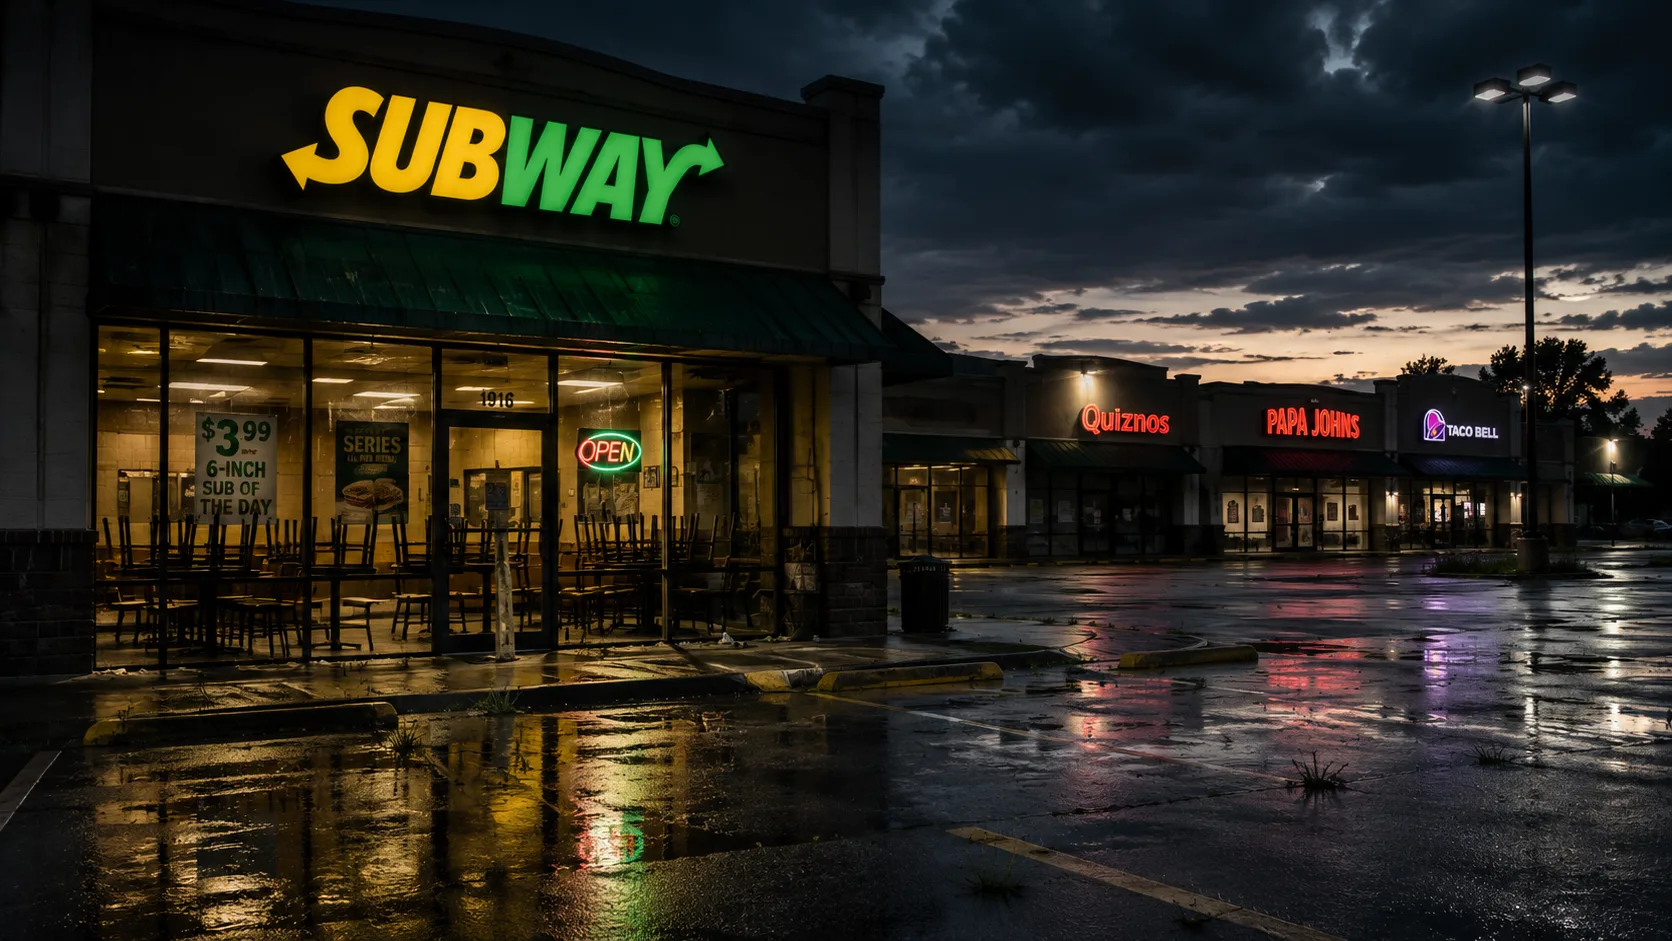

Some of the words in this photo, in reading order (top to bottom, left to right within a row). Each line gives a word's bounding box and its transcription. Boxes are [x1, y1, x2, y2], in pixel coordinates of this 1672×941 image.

[281, 86, 725, 225] SUBWAY
[480, 389, 515, 408] 1916
[1081, 403, 1170, 435] Quiznos
[1267, 407, 1308, 436] PAPA
[1311, 408, 1360, 439] JOHNS
[1446, 424, 1473, 438] TACO
[1474, 426, 1499, 439] BELL
[343, 435, 402, 454] SERIES
[579, 440, 635, 463] OPEN
[206, 460, 266, 478] 6-INCH
[202, 480, 235, 496] SUB
[240, 481, 260, 496] OF
[200, 498, 233, 515] THE
[238, 499, 272, 515] DAY
